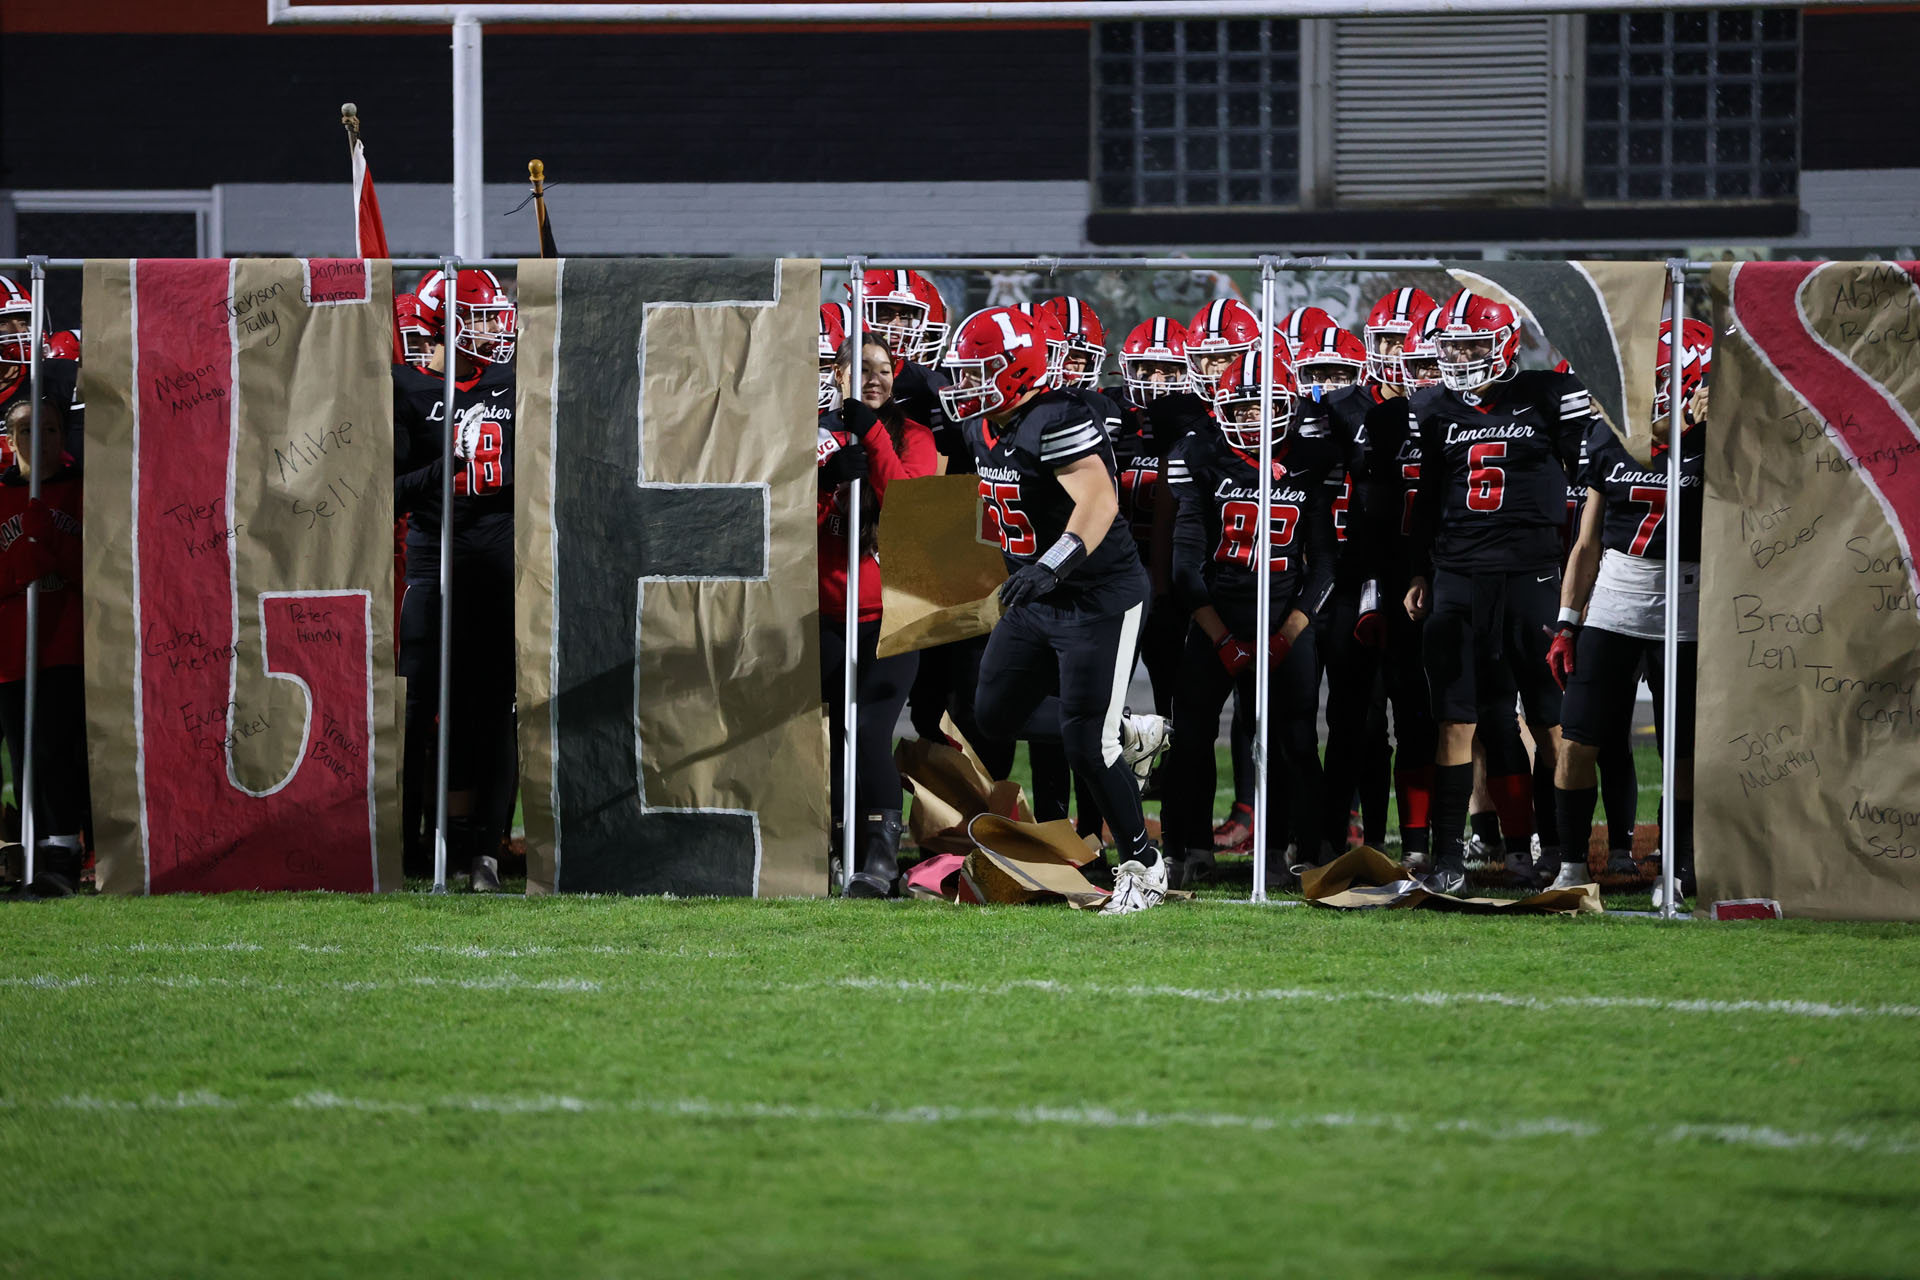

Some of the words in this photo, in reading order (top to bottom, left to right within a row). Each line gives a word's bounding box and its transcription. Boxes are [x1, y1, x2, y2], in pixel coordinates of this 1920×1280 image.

[213, 282, 285, 323] Jackson
[1832, 279, 1916, 331] Abby
[239, 309, 281, 347] Tully
[991, 312, 1033, 350] L
[425, 401, 512, 421] Lnster
[1782, 408, 1862, 443] Jack
[274, 421, 352, 483] Mike
[1445, 423, 1535, 444] Lancaster
[974, 456, 1021, 482] Lancaster
[1466, 442, 1505, 512] 6
[163, 497, 222, 531] Tyler
[292, 477, 359, 530] Sell
[1627, 485, 1668, 557] 7
[1213, 500, 1300, 572] 82
[1740, 504, 1793, 542] Matt
[1845, 535, 1915, 574] Sam
[289, 603, 332, 624] Peter
[1732, 593, 1825, 635] Brad
[143, 622, 208, 658] Gabe
[296, 628, 343, 645] Handy
[1747, 639, 1798, 670] Len
[167, 640, 245, 676] Kerner
[1803, 664, 1914, 706] Tommy
[179, 701, 240, 733] Evan
[321, 713, 362, 757] Travis
[1728, 724, 1795, 762] John
[1738, 748, 1822, 799] McCarthy
[1867, 835, 1920, 859] Seb
